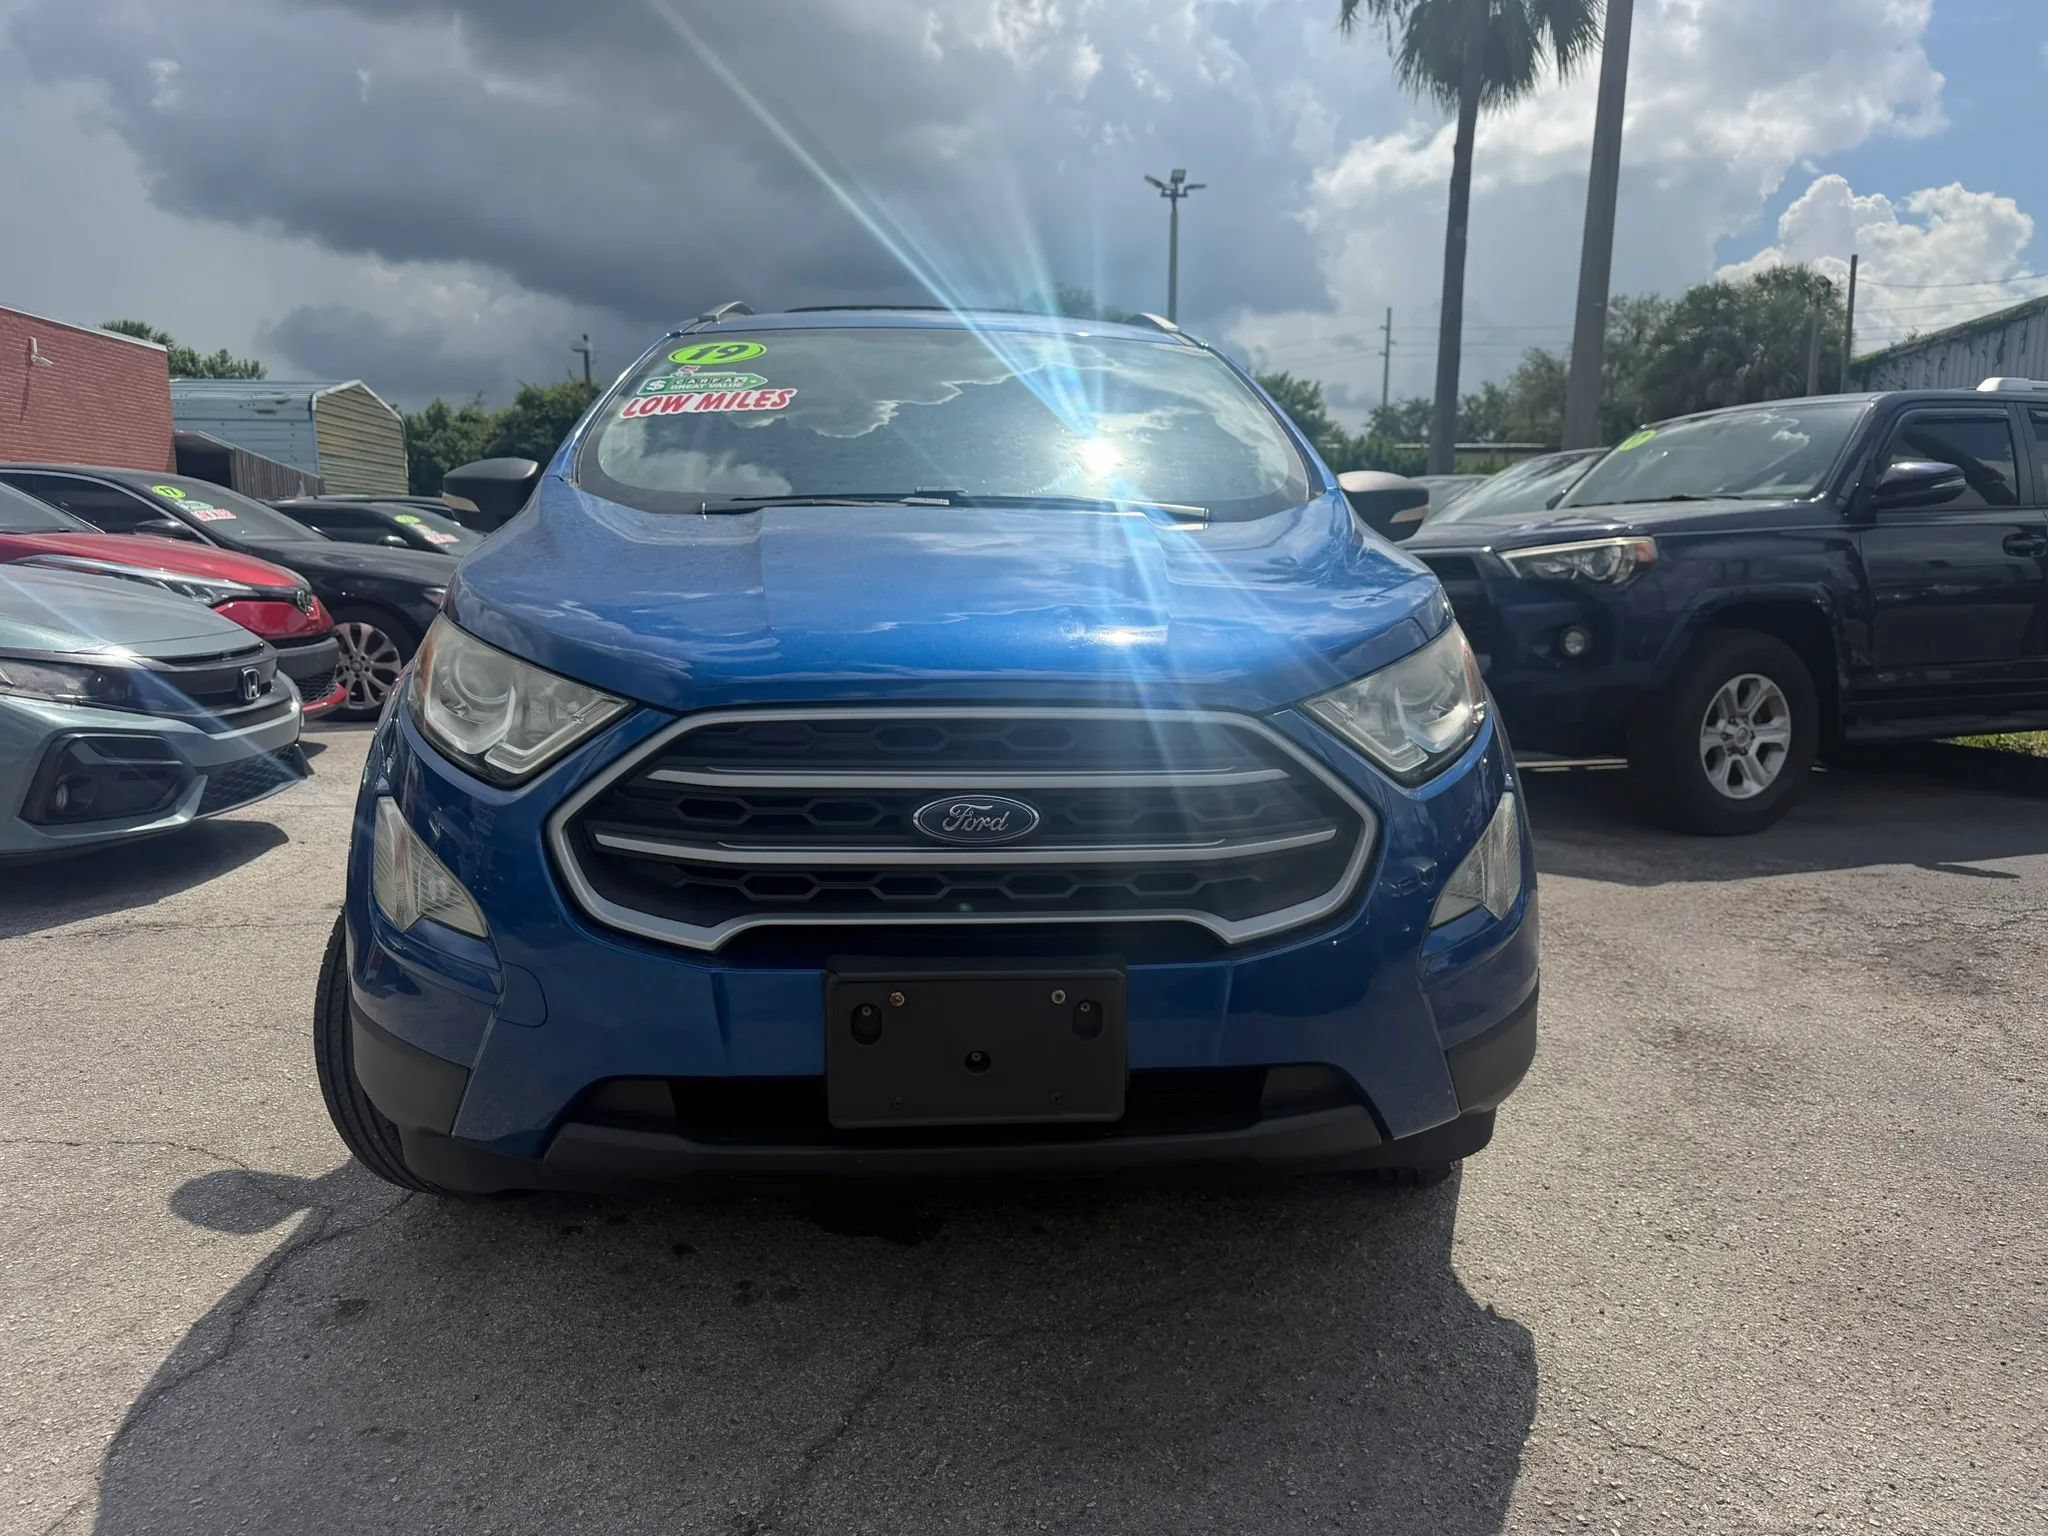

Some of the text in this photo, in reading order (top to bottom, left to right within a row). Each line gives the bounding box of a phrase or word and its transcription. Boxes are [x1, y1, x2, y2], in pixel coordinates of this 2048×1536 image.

[686, 344, 750, 361] 19
[622, 389, 794, 417] LOW MILES
[942, 803, 1010, 832] Ford
